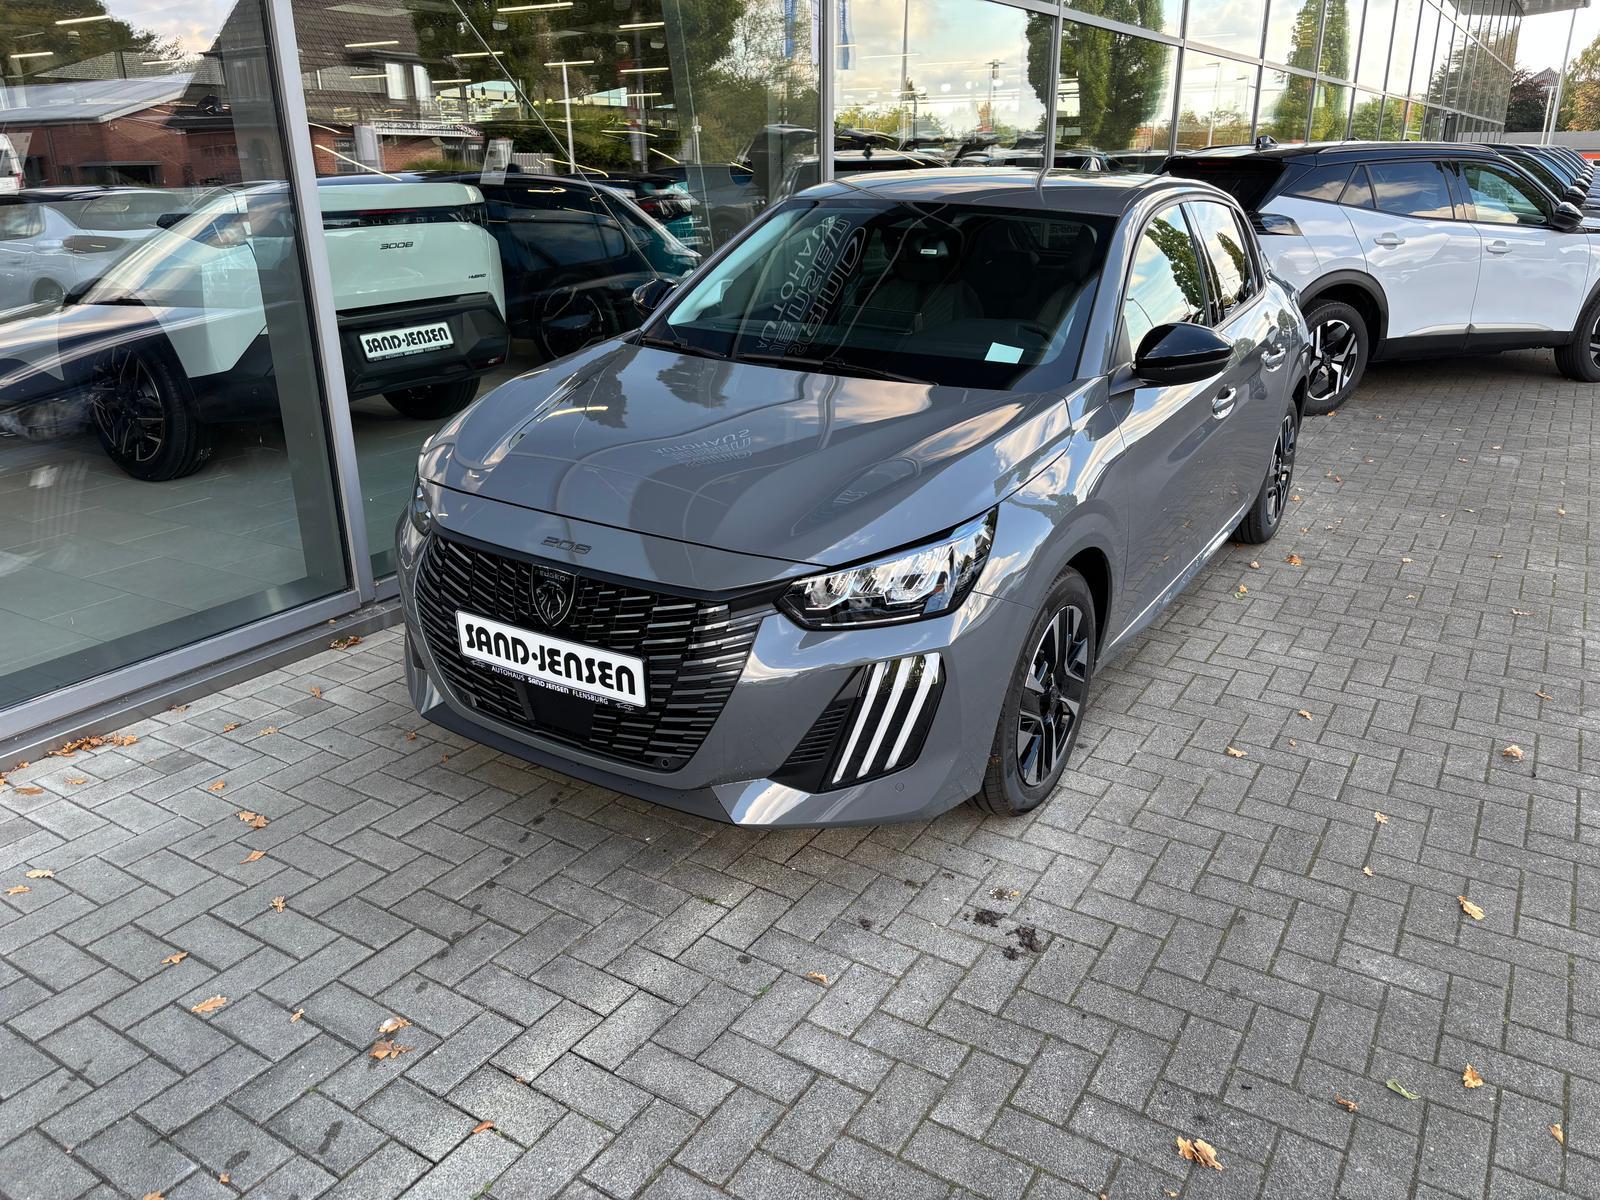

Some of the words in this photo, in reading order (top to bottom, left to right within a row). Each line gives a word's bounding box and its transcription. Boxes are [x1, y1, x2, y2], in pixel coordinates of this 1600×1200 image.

[379, 240, 415, 250] 3008
[540, 536, 592, 554] 208
[491, 665, 526, 682] AUTOHAUS
[527, 676, 546, 688] SAND
[545, 682, 569, 695] JENSEN
[572, 689, 609, 706] FLENSBURG
